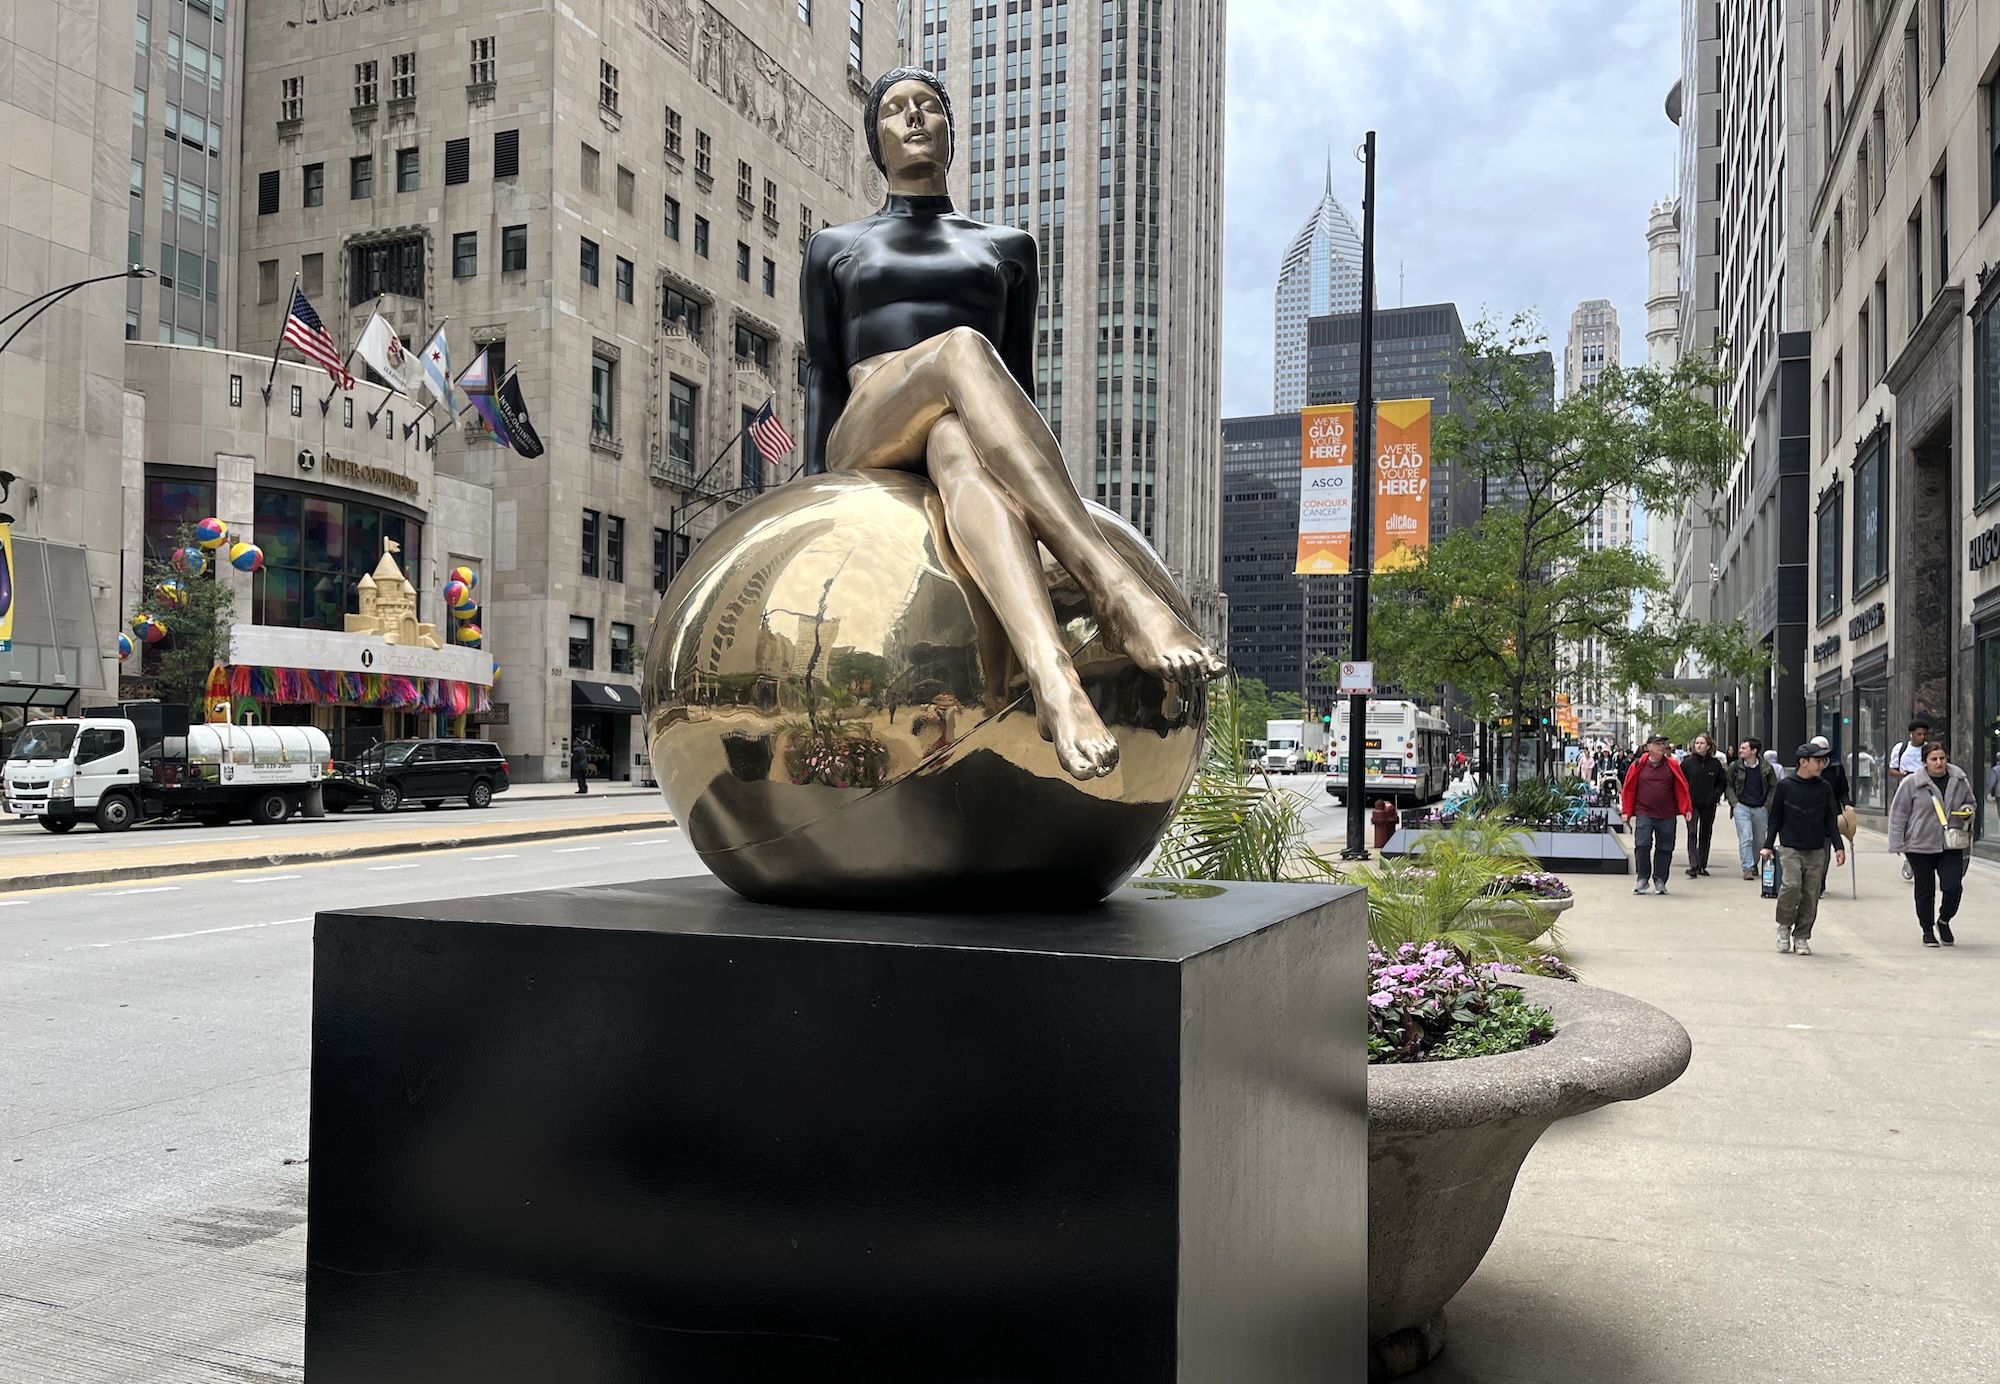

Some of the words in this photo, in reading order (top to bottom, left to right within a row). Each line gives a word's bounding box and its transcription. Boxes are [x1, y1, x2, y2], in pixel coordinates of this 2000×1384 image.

[1313, 416, 1340, 426] WE'RE
[1309, 425, 1344, 438] GLAD
[1311, 437, 1342, 446] YOU'RE
[1310, 444, 1347, 463] HERE!
[1384, 443, 1418, 455] WE'RE
[1378, 454, 1423, 469] GLAD
[1381, 468, 1420, 479] YOU'RE
[1311, 477, 1343, 488] ASCO
[1378, 478, 1427, 502] HERE!
[1304, 499, 1348, 508] CONQUER
[1385, 513, 1417, 530] CHICAGO
[1969, 523, 2000, 571] HUGO
